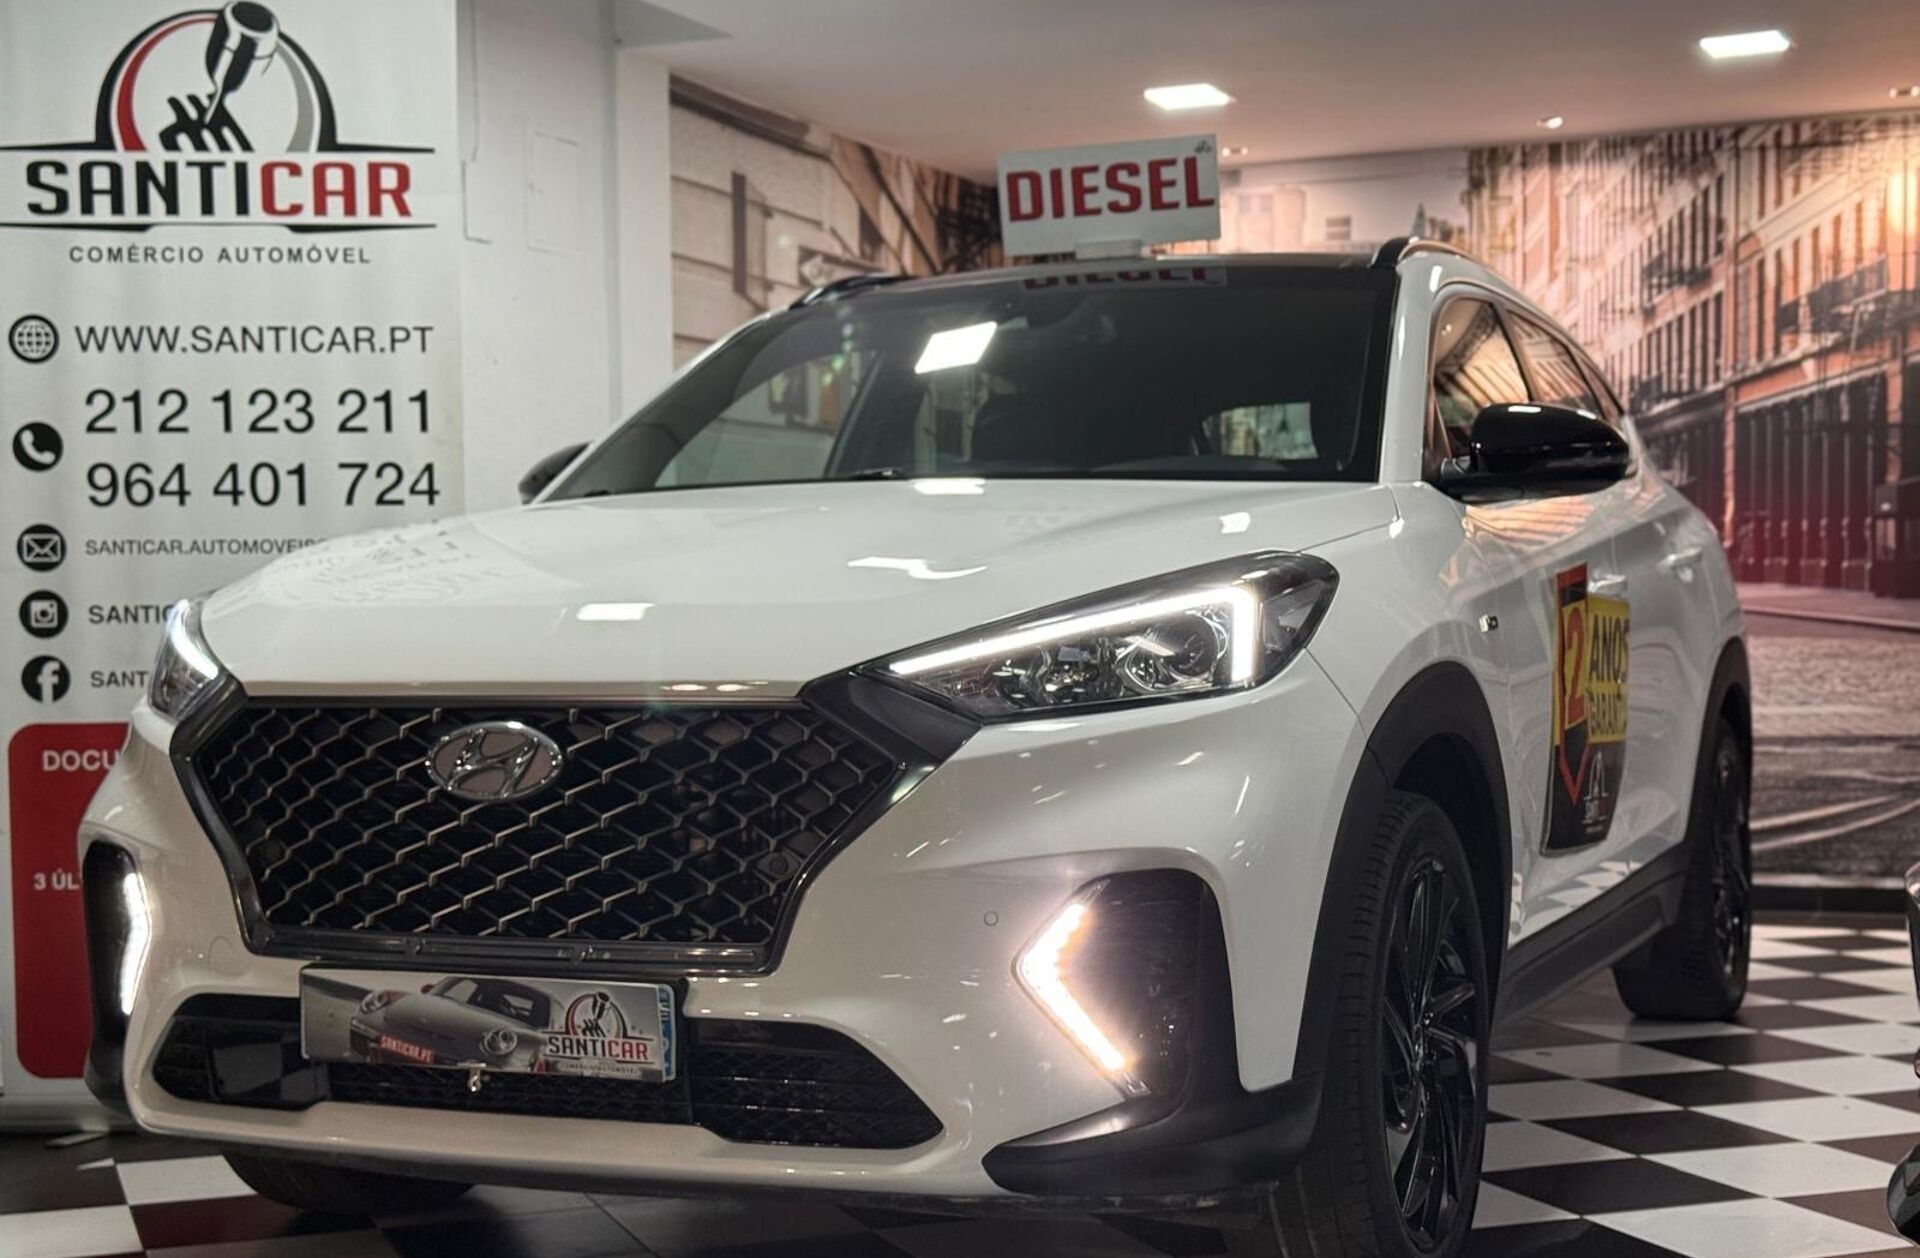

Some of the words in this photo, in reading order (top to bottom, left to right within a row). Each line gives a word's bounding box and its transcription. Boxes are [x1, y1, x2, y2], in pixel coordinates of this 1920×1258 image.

[26, 160, 412, 216] SANTICAR
[1006, 156, 1215, 222] DIESEL
[69, 243, 203, 264] COMÉRCIO
[218, 243, 371, 264] AUTOMÓVEL
[75, 325, 434, 353] WWW.SANTICAR.PT
[85, 388, 189, 433] 212
[211, 388, 315, 433] 123
[337, 388, 430, 433] 211
[87, 462, 191, 507] 964
[213, 462, 308, 507] 401
[338, 462, 440, 507] 724
[90, 670, 149, 688] SANT
[33, 872, 46, 890] 3
[548, 1036, 649, 1061] SANTICAR
